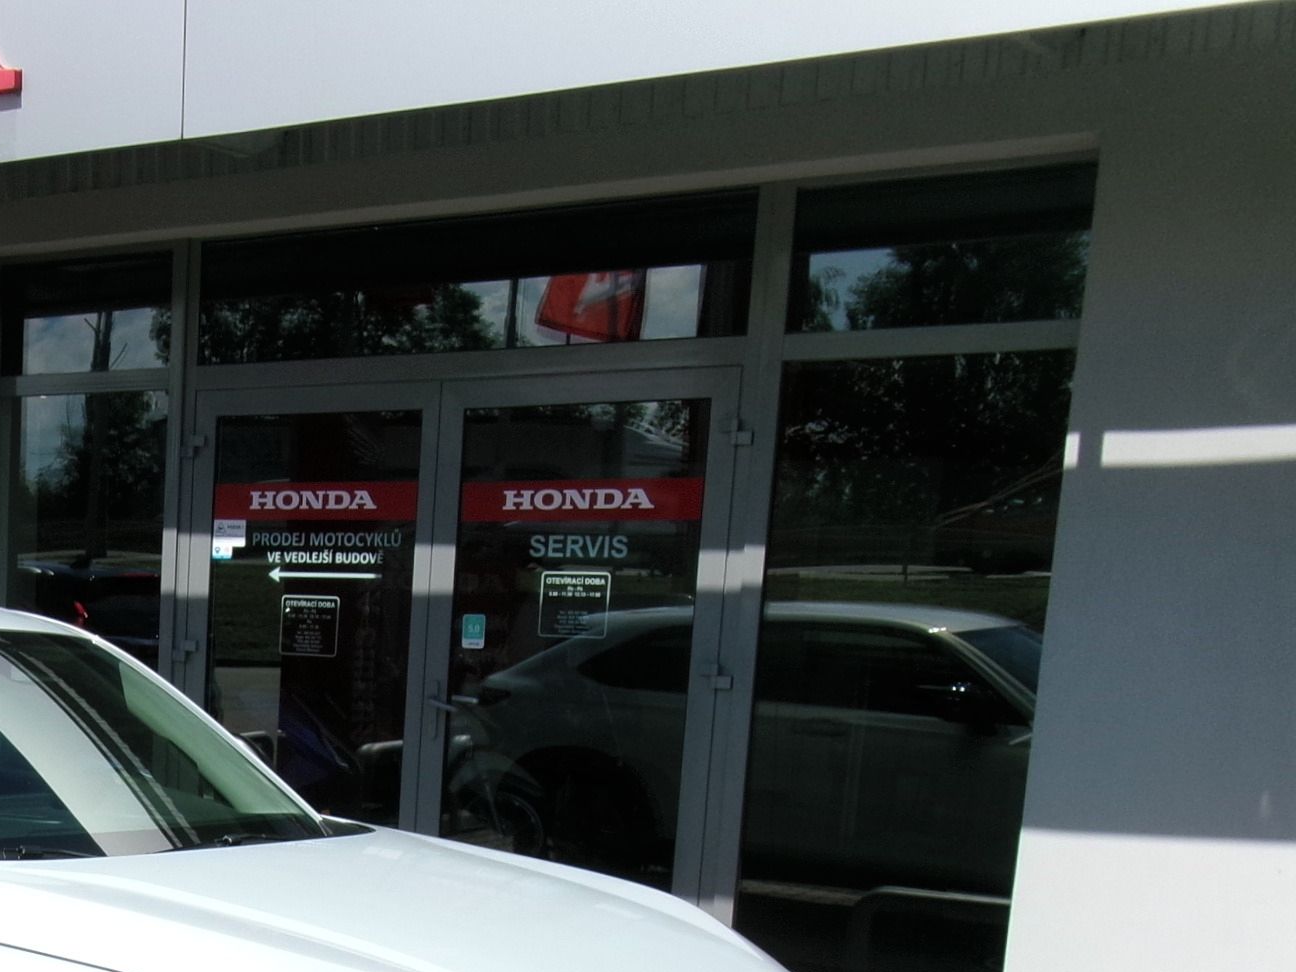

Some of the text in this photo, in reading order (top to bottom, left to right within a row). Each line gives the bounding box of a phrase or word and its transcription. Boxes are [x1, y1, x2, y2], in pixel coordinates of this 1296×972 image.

[249, 489, 378, 510] HONDA
[502, 488, 655, 511] HONDA
[253, 528, 402, 547] PRODEJ MOTOCYKLŮ
[529, 534, 629, 559] SERVIS
[267, 549, 384, 565] VE VEDLEJŠÍ BUDOVĚ
